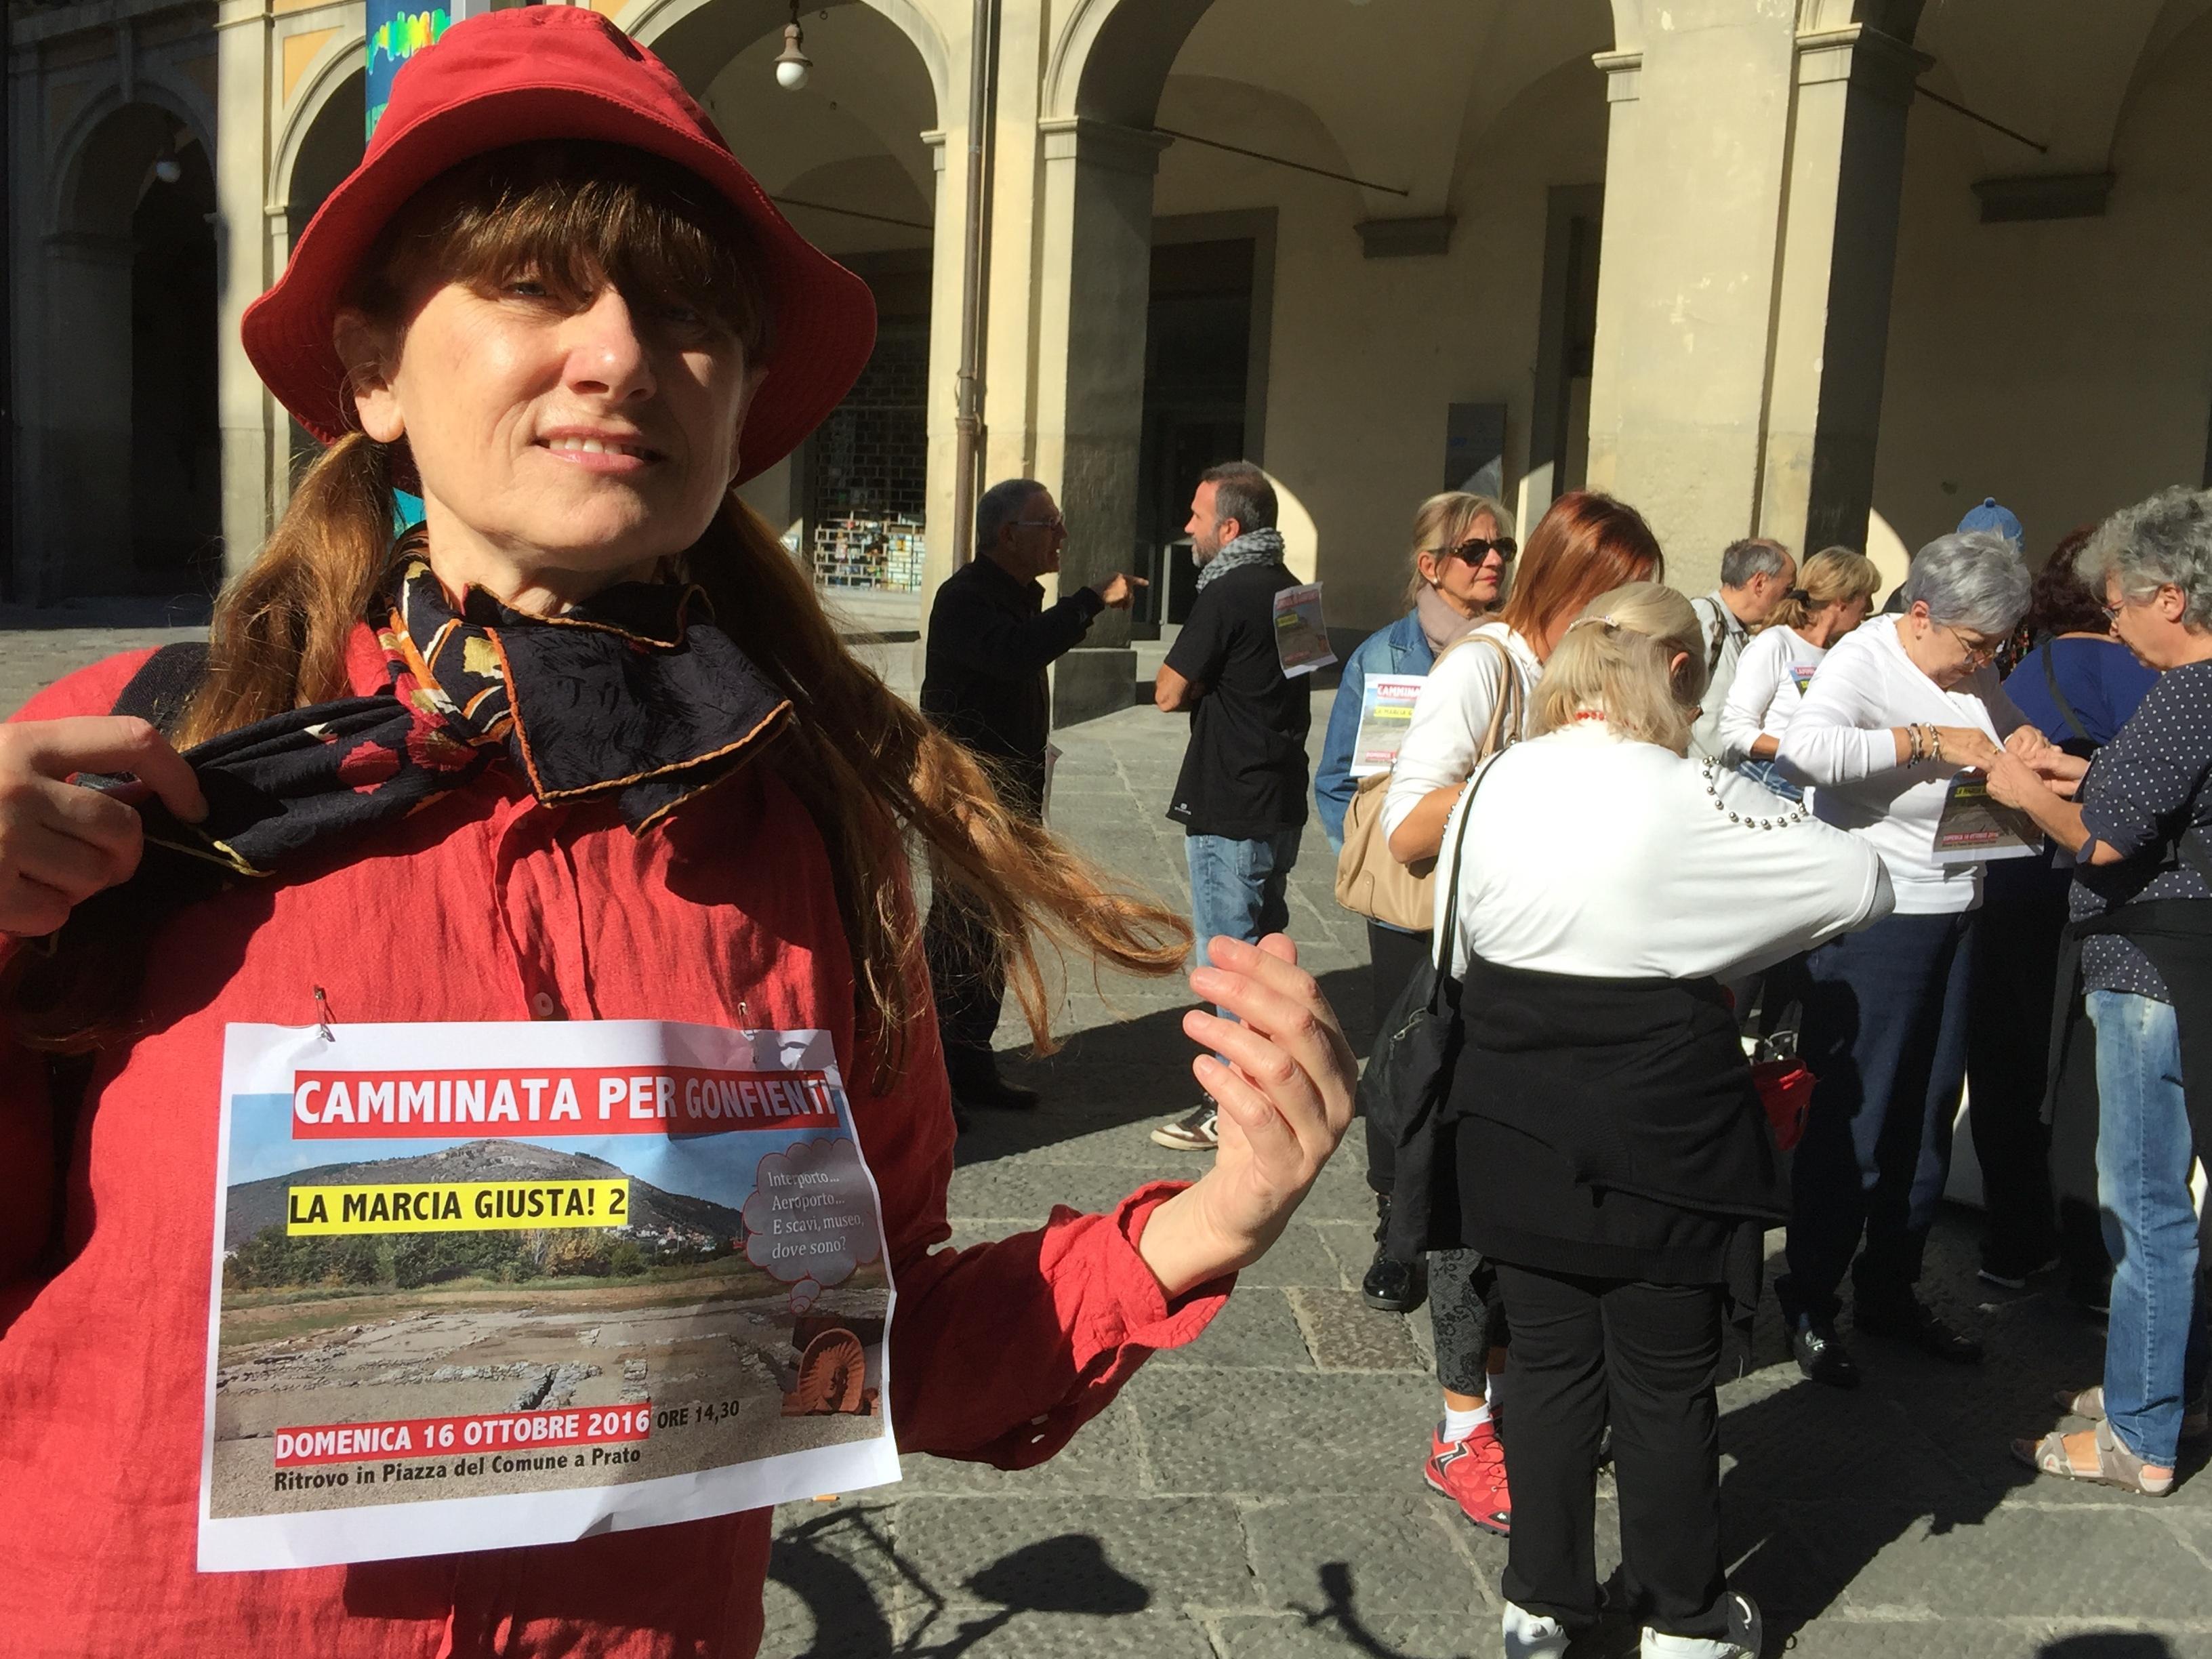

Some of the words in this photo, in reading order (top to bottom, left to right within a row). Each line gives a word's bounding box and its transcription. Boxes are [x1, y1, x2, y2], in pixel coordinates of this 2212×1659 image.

[1378, 685, 1420, 697] CAMMINA
[295, 1078, 581, 1124] CAMMINATA
[598, 1076, 677, 1120] PER
[685, 1078, 836, 1118] GONFIENTI
[290, 1195, 329, 1224] LA
[342, 1191, 462, 1222] MARCIA
[474, 1188, 595, 1218] GIUSTA!
[609, 1188, 626, 1214] 2
[773, 1219, 782, 1234] E
[785, 1217, 821, 1233] scavi,
[823, 1214, 865, 1229] museo,
[772, 1243, 806, 1259] dove
[810, 1236, 846, 1254] sono?
[276, 1426, 411, 1459] DOMENICA
[424, 1424, 455, 1448] 16
[464, 1414, 579, 1446] OTTOBRE
[588, 1410, 649, 1437] 2016
[657, 1408, 689, 1429] ORE
[695, 1400, 739, 1425] 14,30
[274, 1471, 348, 1490] Ritrovo
[357, 1467, 375, 1484] in
[383, 1463, 447, 1482] Piazza
[454, 1457, 485, 1476] del
[492, 1455, 567, 1473] Comune
[575, 1454, 584, 1467] a
[592, 1448, 640, 1465] Prato
